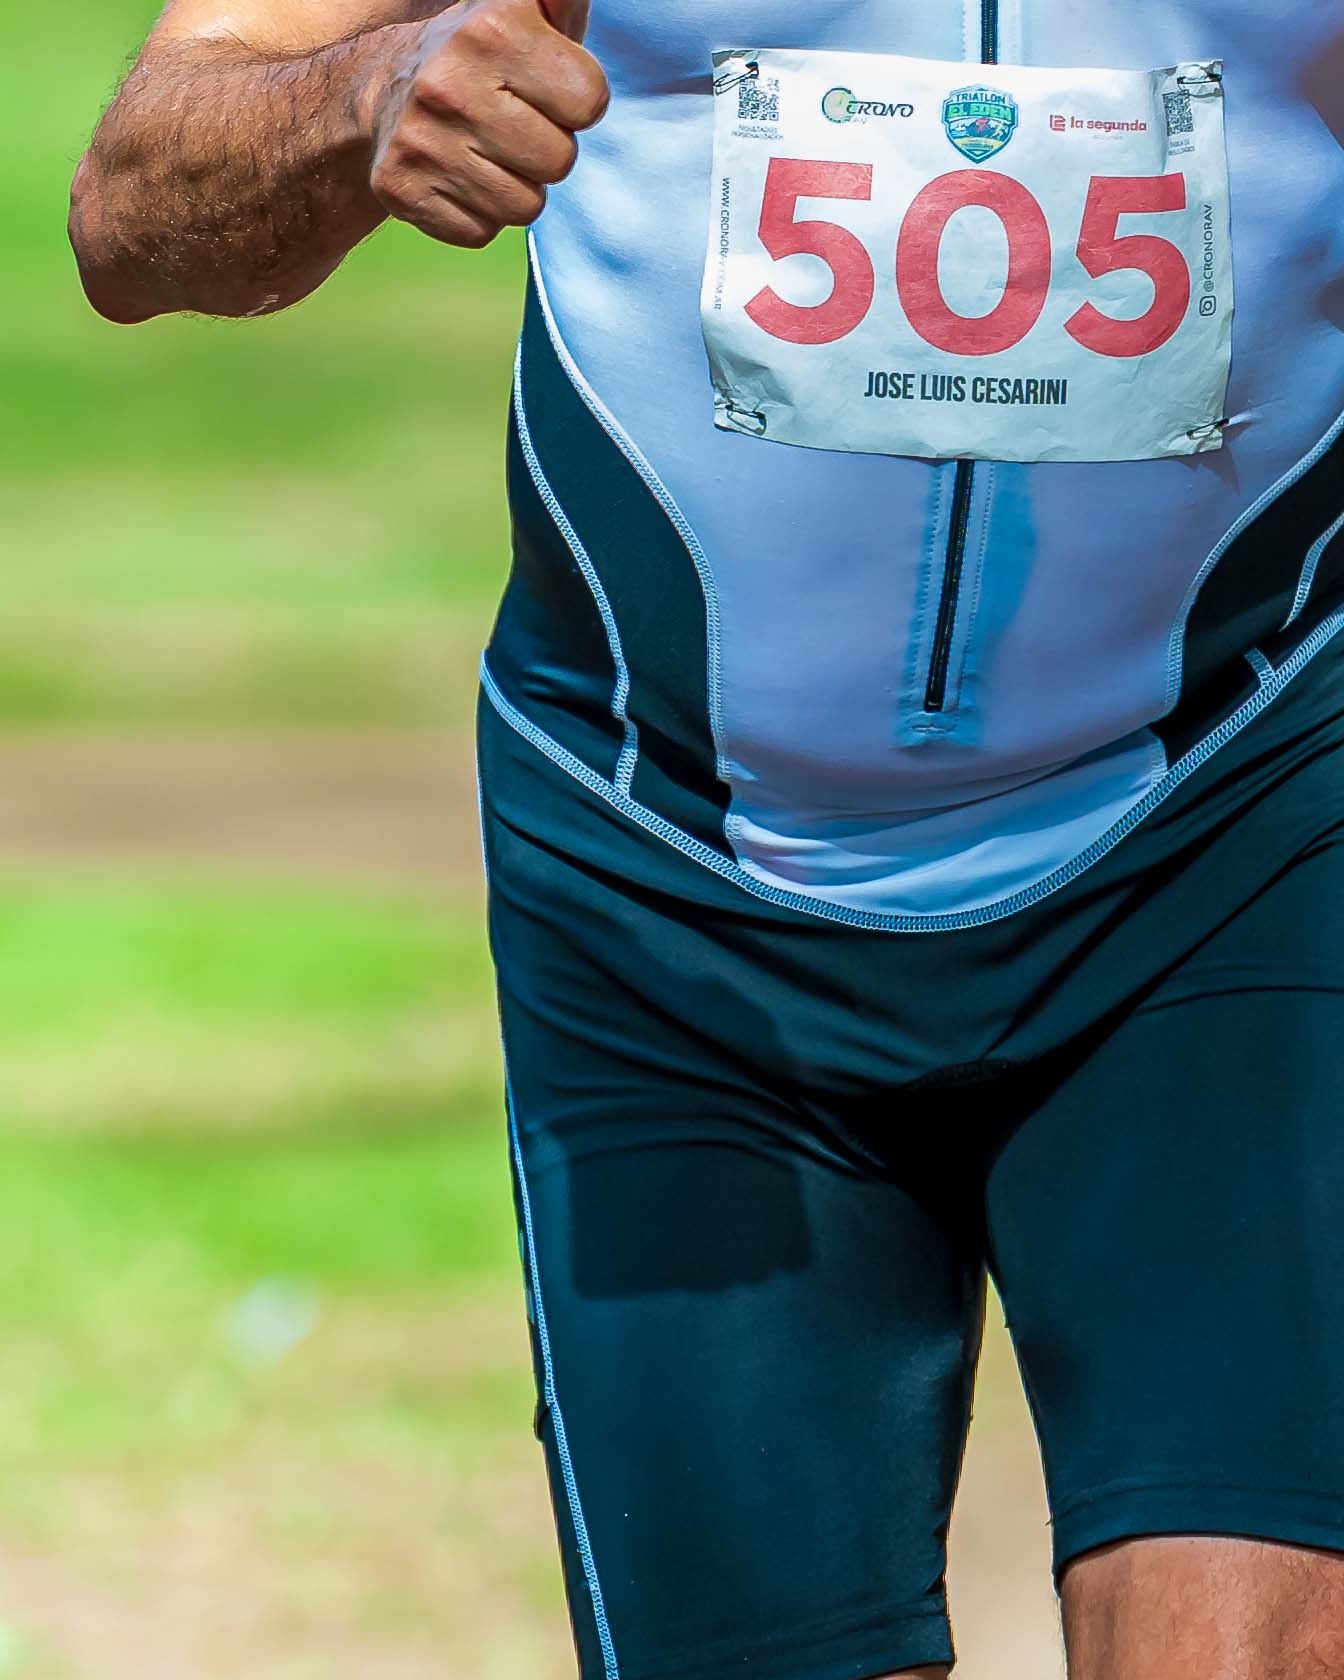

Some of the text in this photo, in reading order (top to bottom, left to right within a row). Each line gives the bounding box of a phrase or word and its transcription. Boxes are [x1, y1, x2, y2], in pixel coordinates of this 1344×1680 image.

[955, 92, 1006, 105] TRIATLON
[1070, 116, 1147, 132] la segunda
[743, 156, 1191, 358] 505
[1203, 204, 1215, 293] @CRONORAV
[864, 371, 1068, 405] JOSE LUIS CESARINI
